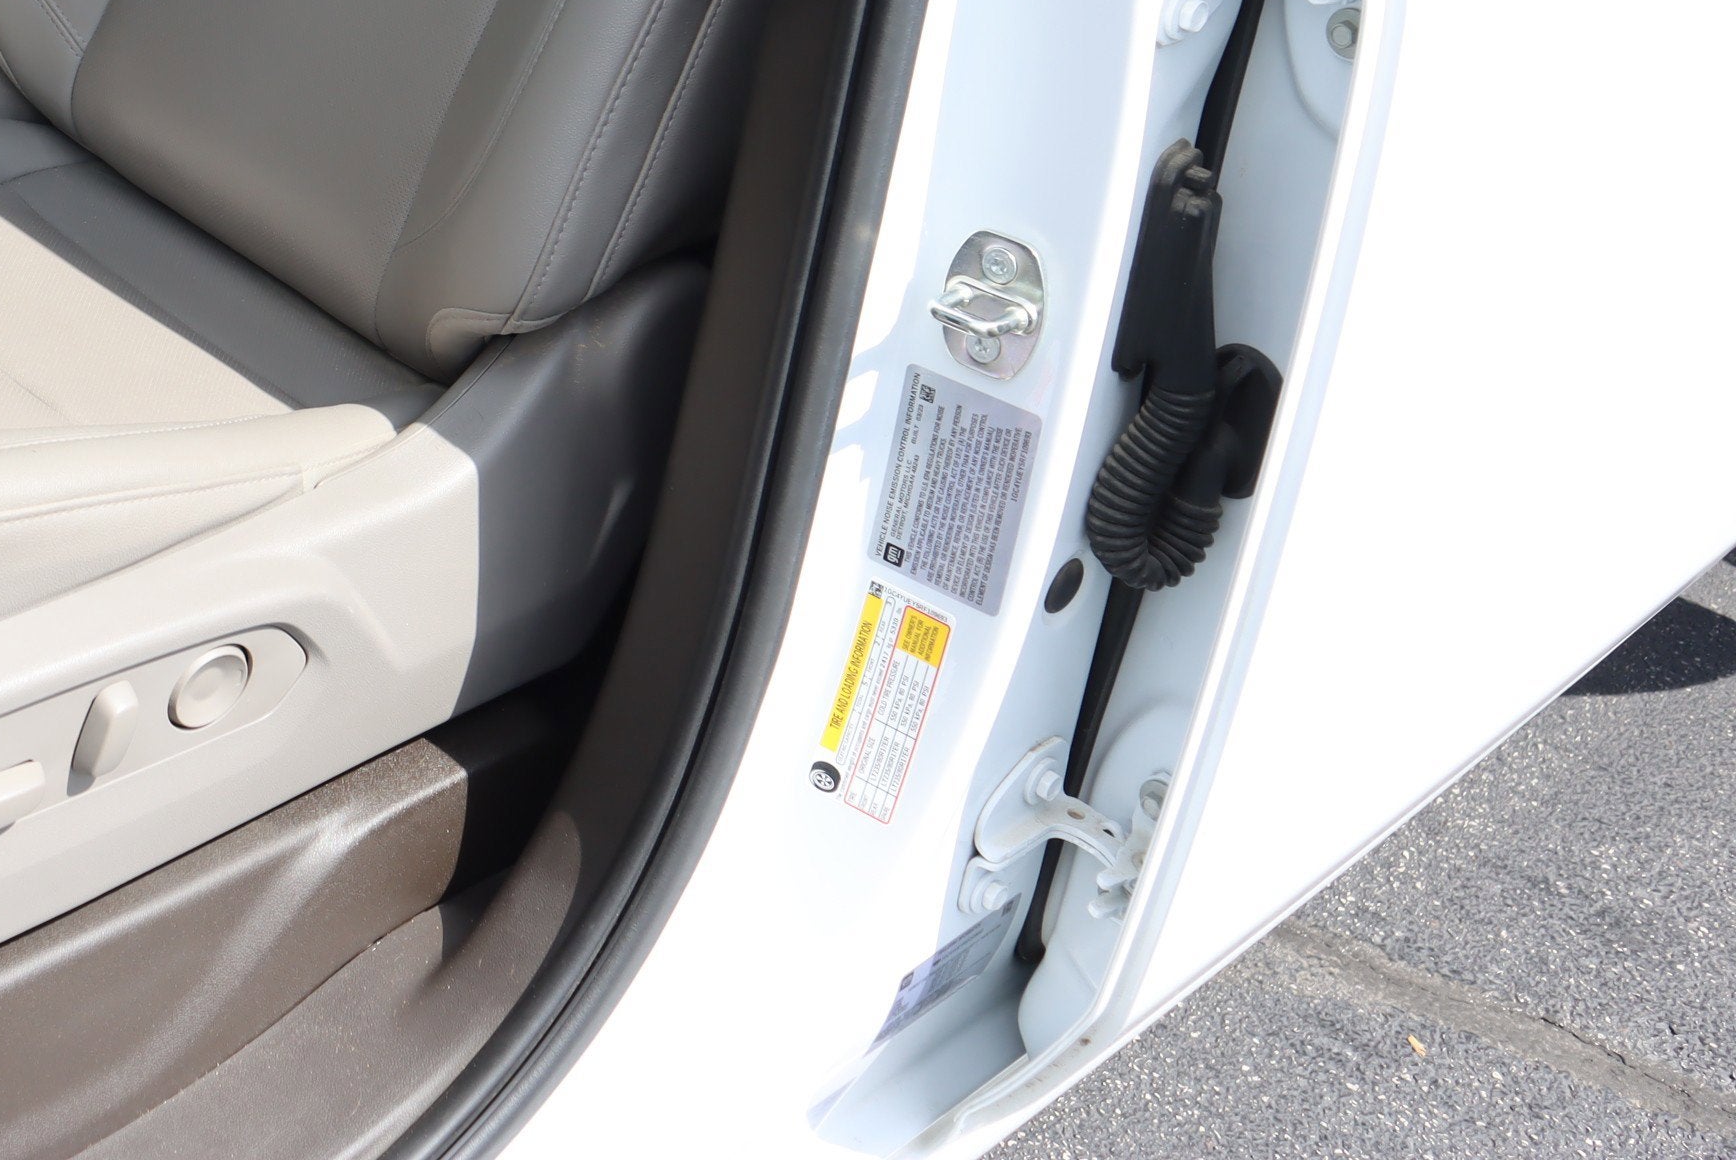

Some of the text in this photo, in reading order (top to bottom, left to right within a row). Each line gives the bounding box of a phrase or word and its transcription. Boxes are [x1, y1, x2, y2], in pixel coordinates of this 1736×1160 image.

[876, 373, 921, 557] VEHICLE NOISE EMISSION CONTROL INFORMATION
[891, 506, 902, 538] GENERAL
[899, 475, 909, 504] MOTORS
[897, 510, 908, 540] DETROIT,
[904, 474, 915, 509] MICHIGAN
[850, 621, 872, 667] INFORMATION
[910, 632, 920, 654] MANUAL
[918, 625, 931, 656] ADDITIONAL
[925, 626, 940, 661] INFORMATION
[840, 666, 858, 698] LOADING
[830, 713, 843, 731] TIRE
[835, 697, 848, 714] AND
